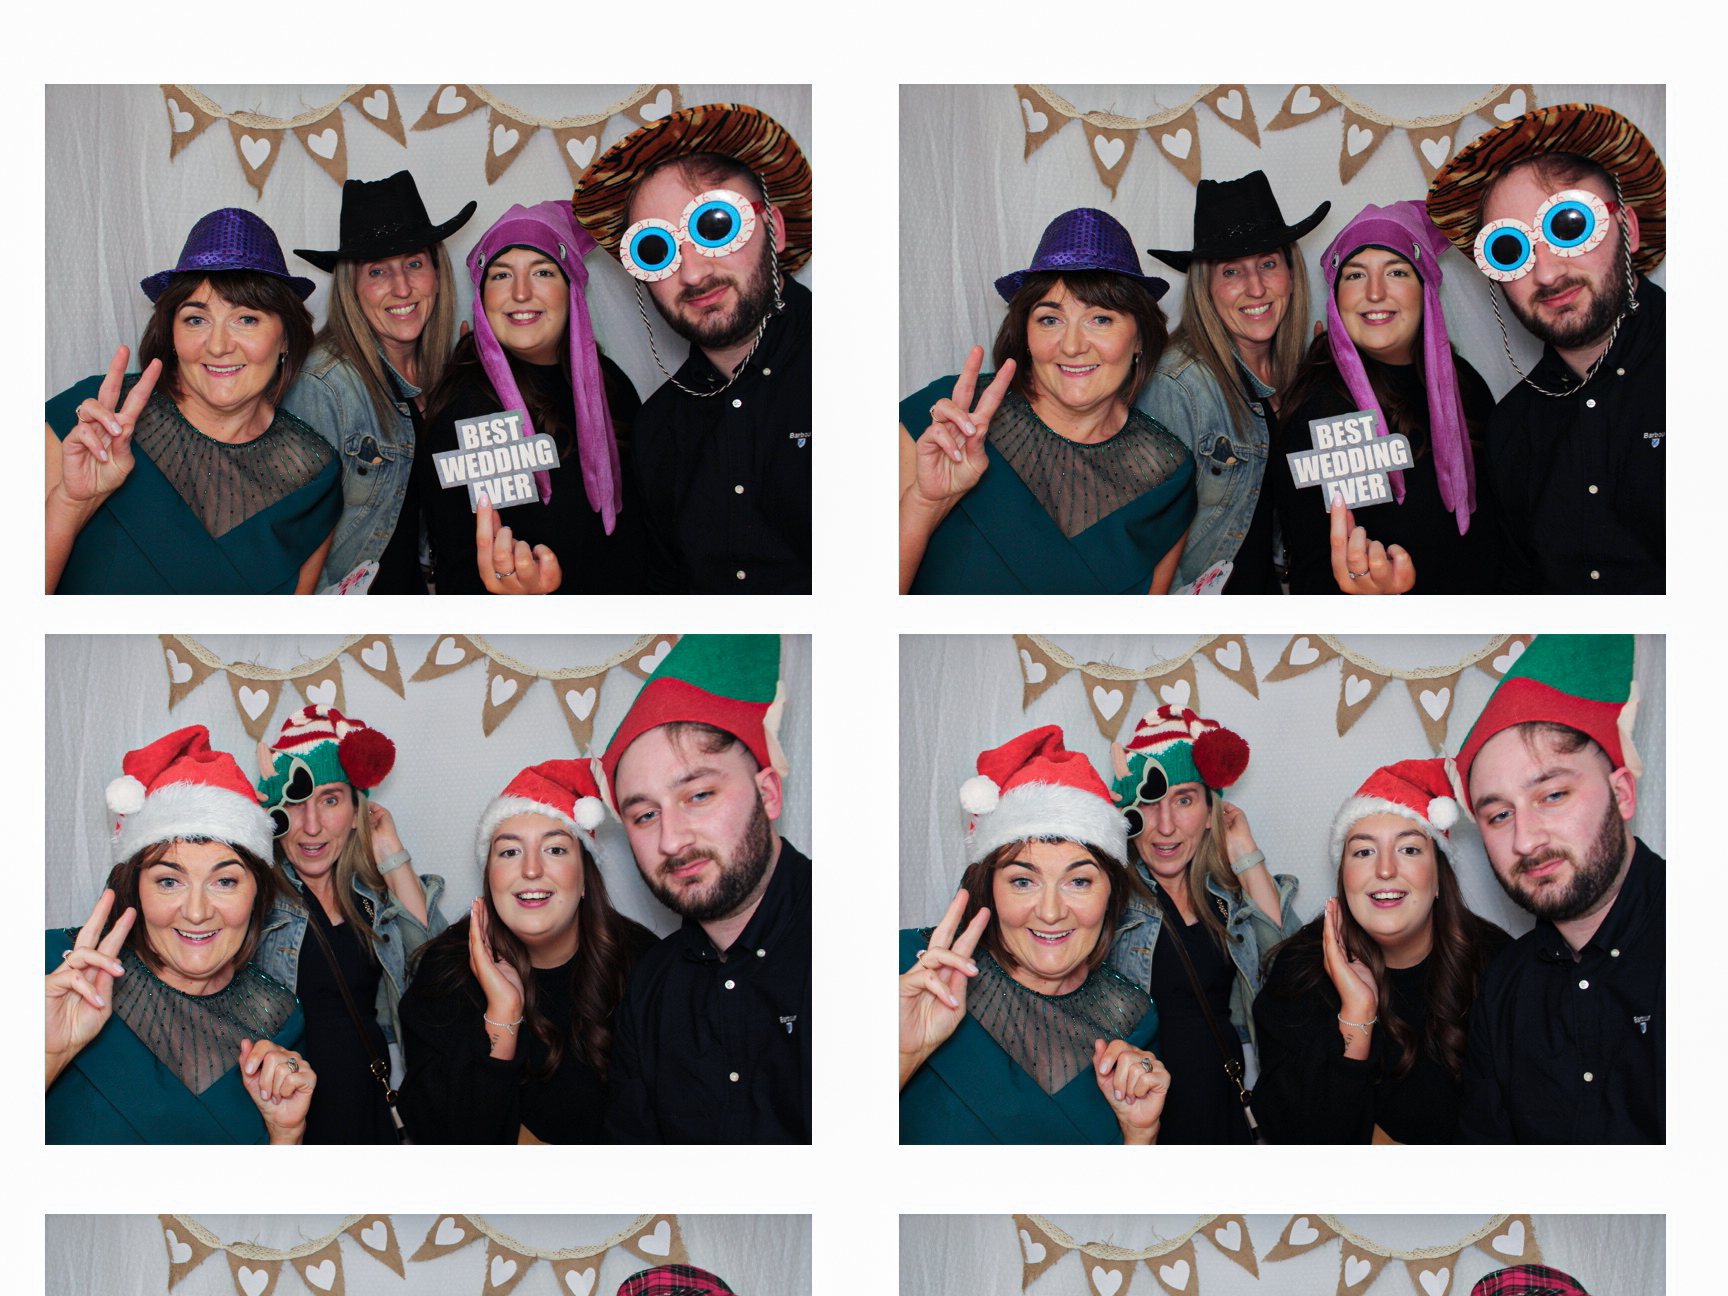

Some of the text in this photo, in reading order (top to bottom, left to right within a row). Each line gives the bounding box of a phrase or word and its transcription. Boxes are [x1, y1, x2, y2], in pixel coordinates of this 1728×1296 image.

[461, 415, 520, 450] BEST
[1315, 415, 1374, 450] BEST
[440, 439, 554, 483] WEDDING
[1294, 439, 1408, 483] WEDDING
